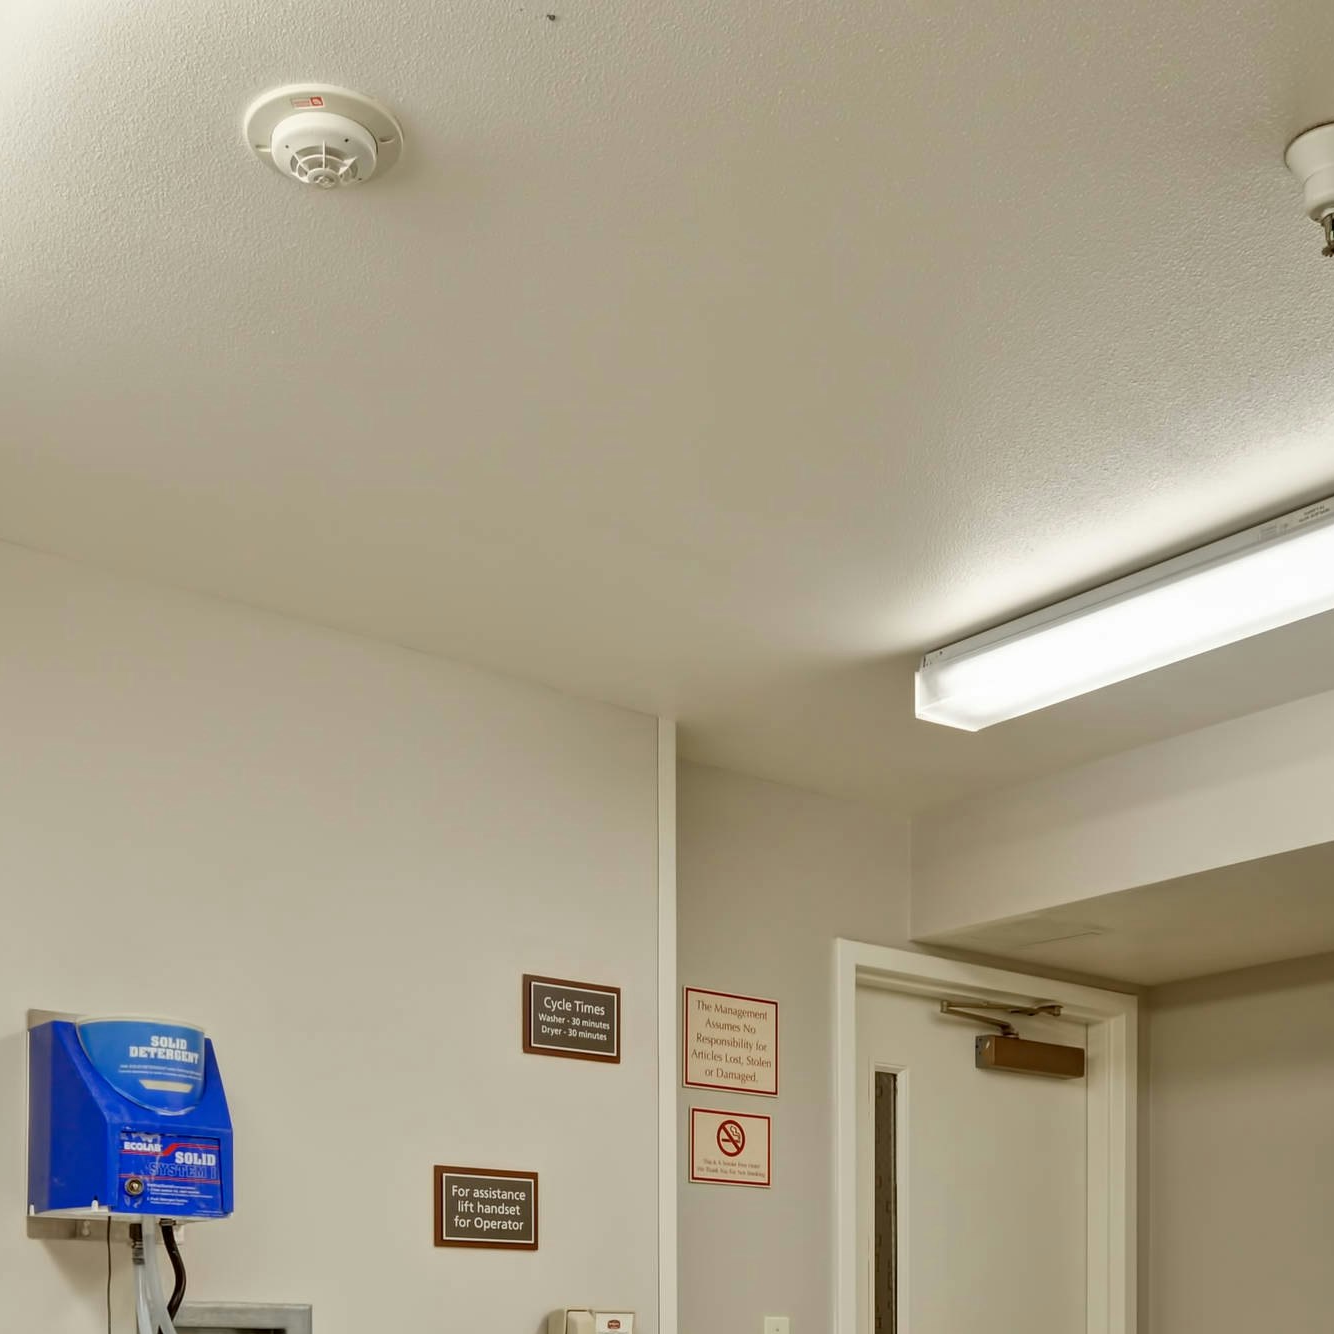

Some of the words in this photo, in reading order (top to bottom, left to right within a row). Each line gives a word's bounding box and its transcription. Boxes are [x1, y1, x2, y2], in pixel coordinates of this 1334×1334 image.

[544, 996, 572, 1012] Cycle
[574, 1001, 605, 1015] Times
[697, 1000, 712, 1010] The
[714, 1004, 767, 1020] Management
[538, 1013, 565, 1023] Washer
[582, 1020, 610, 1030] minutes
[705, 1018, 740, 1032] Assumes
[744, 1024, 755, 1034] No
[542, 1025, 562, 1036] Dryer
[568, 1029, 577, 1037] 30
[579, 1031, 607, 1040] minutes
[150, 1035, 187, 1049] SOLID
[697, 1033, 753, 1051] Responsibility
[755, 1041, 767, 1051] for
[129, 1046, 199, 1064] DETERGENT
[691, 1049, 722, 1062] Articles
[747, 1056, 771, 1068] Stolen
[174, 1152, 216, 1166] SOLID
[149, 1162, 207, 1178] SYSTEM
[452, 1185, 470, 1197] For
[473, 1188, 526, 1200] assistance
[458, 1200, 474, 1213] lift
[477, 1202, 520, 1215] handset
[454, 1216, 471, 1228] for
[474, 1217, 523, 1231] Operator
